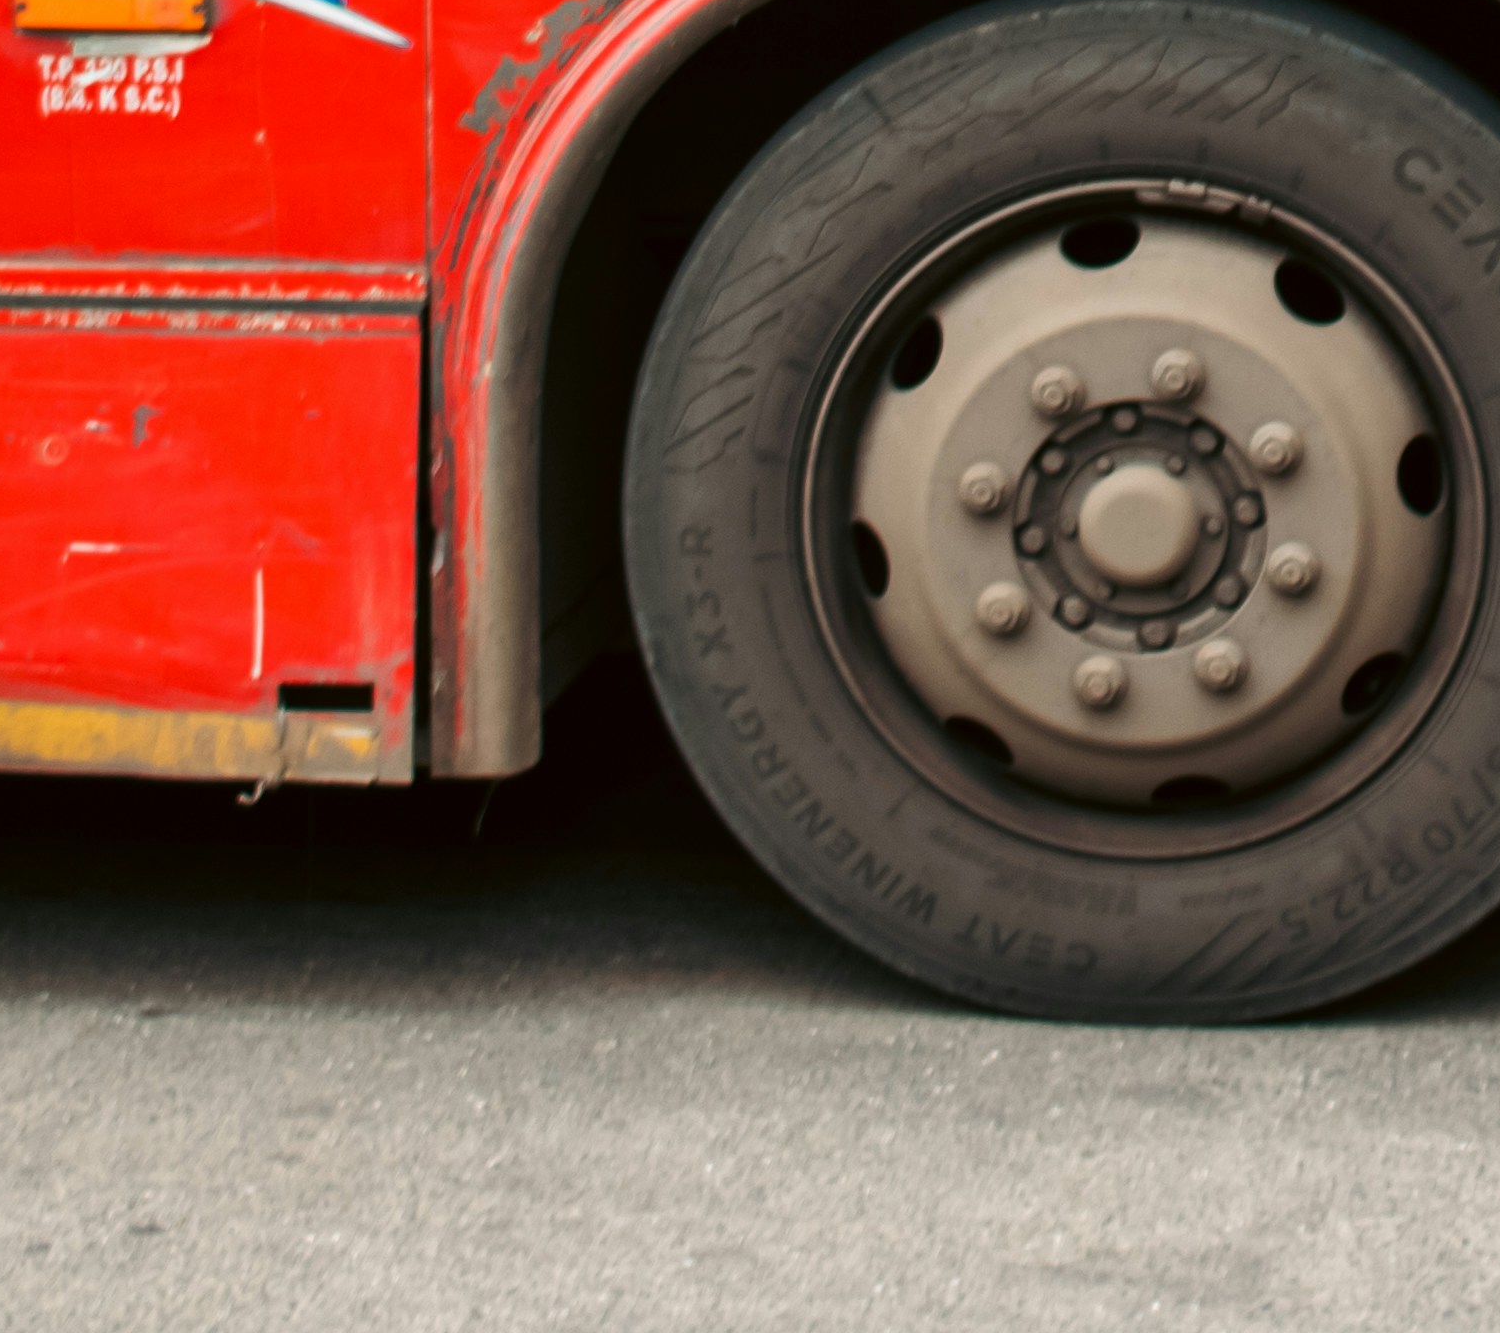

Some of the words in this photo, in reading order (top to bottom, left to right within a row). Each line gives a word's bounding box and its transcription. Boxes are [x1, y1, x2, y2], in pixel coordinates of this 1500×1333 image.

[679, 524, 735, 658] X3-R
[711, 683, 938, 926] WINENERGY
[951, 911, 1099, 979] CEAT
